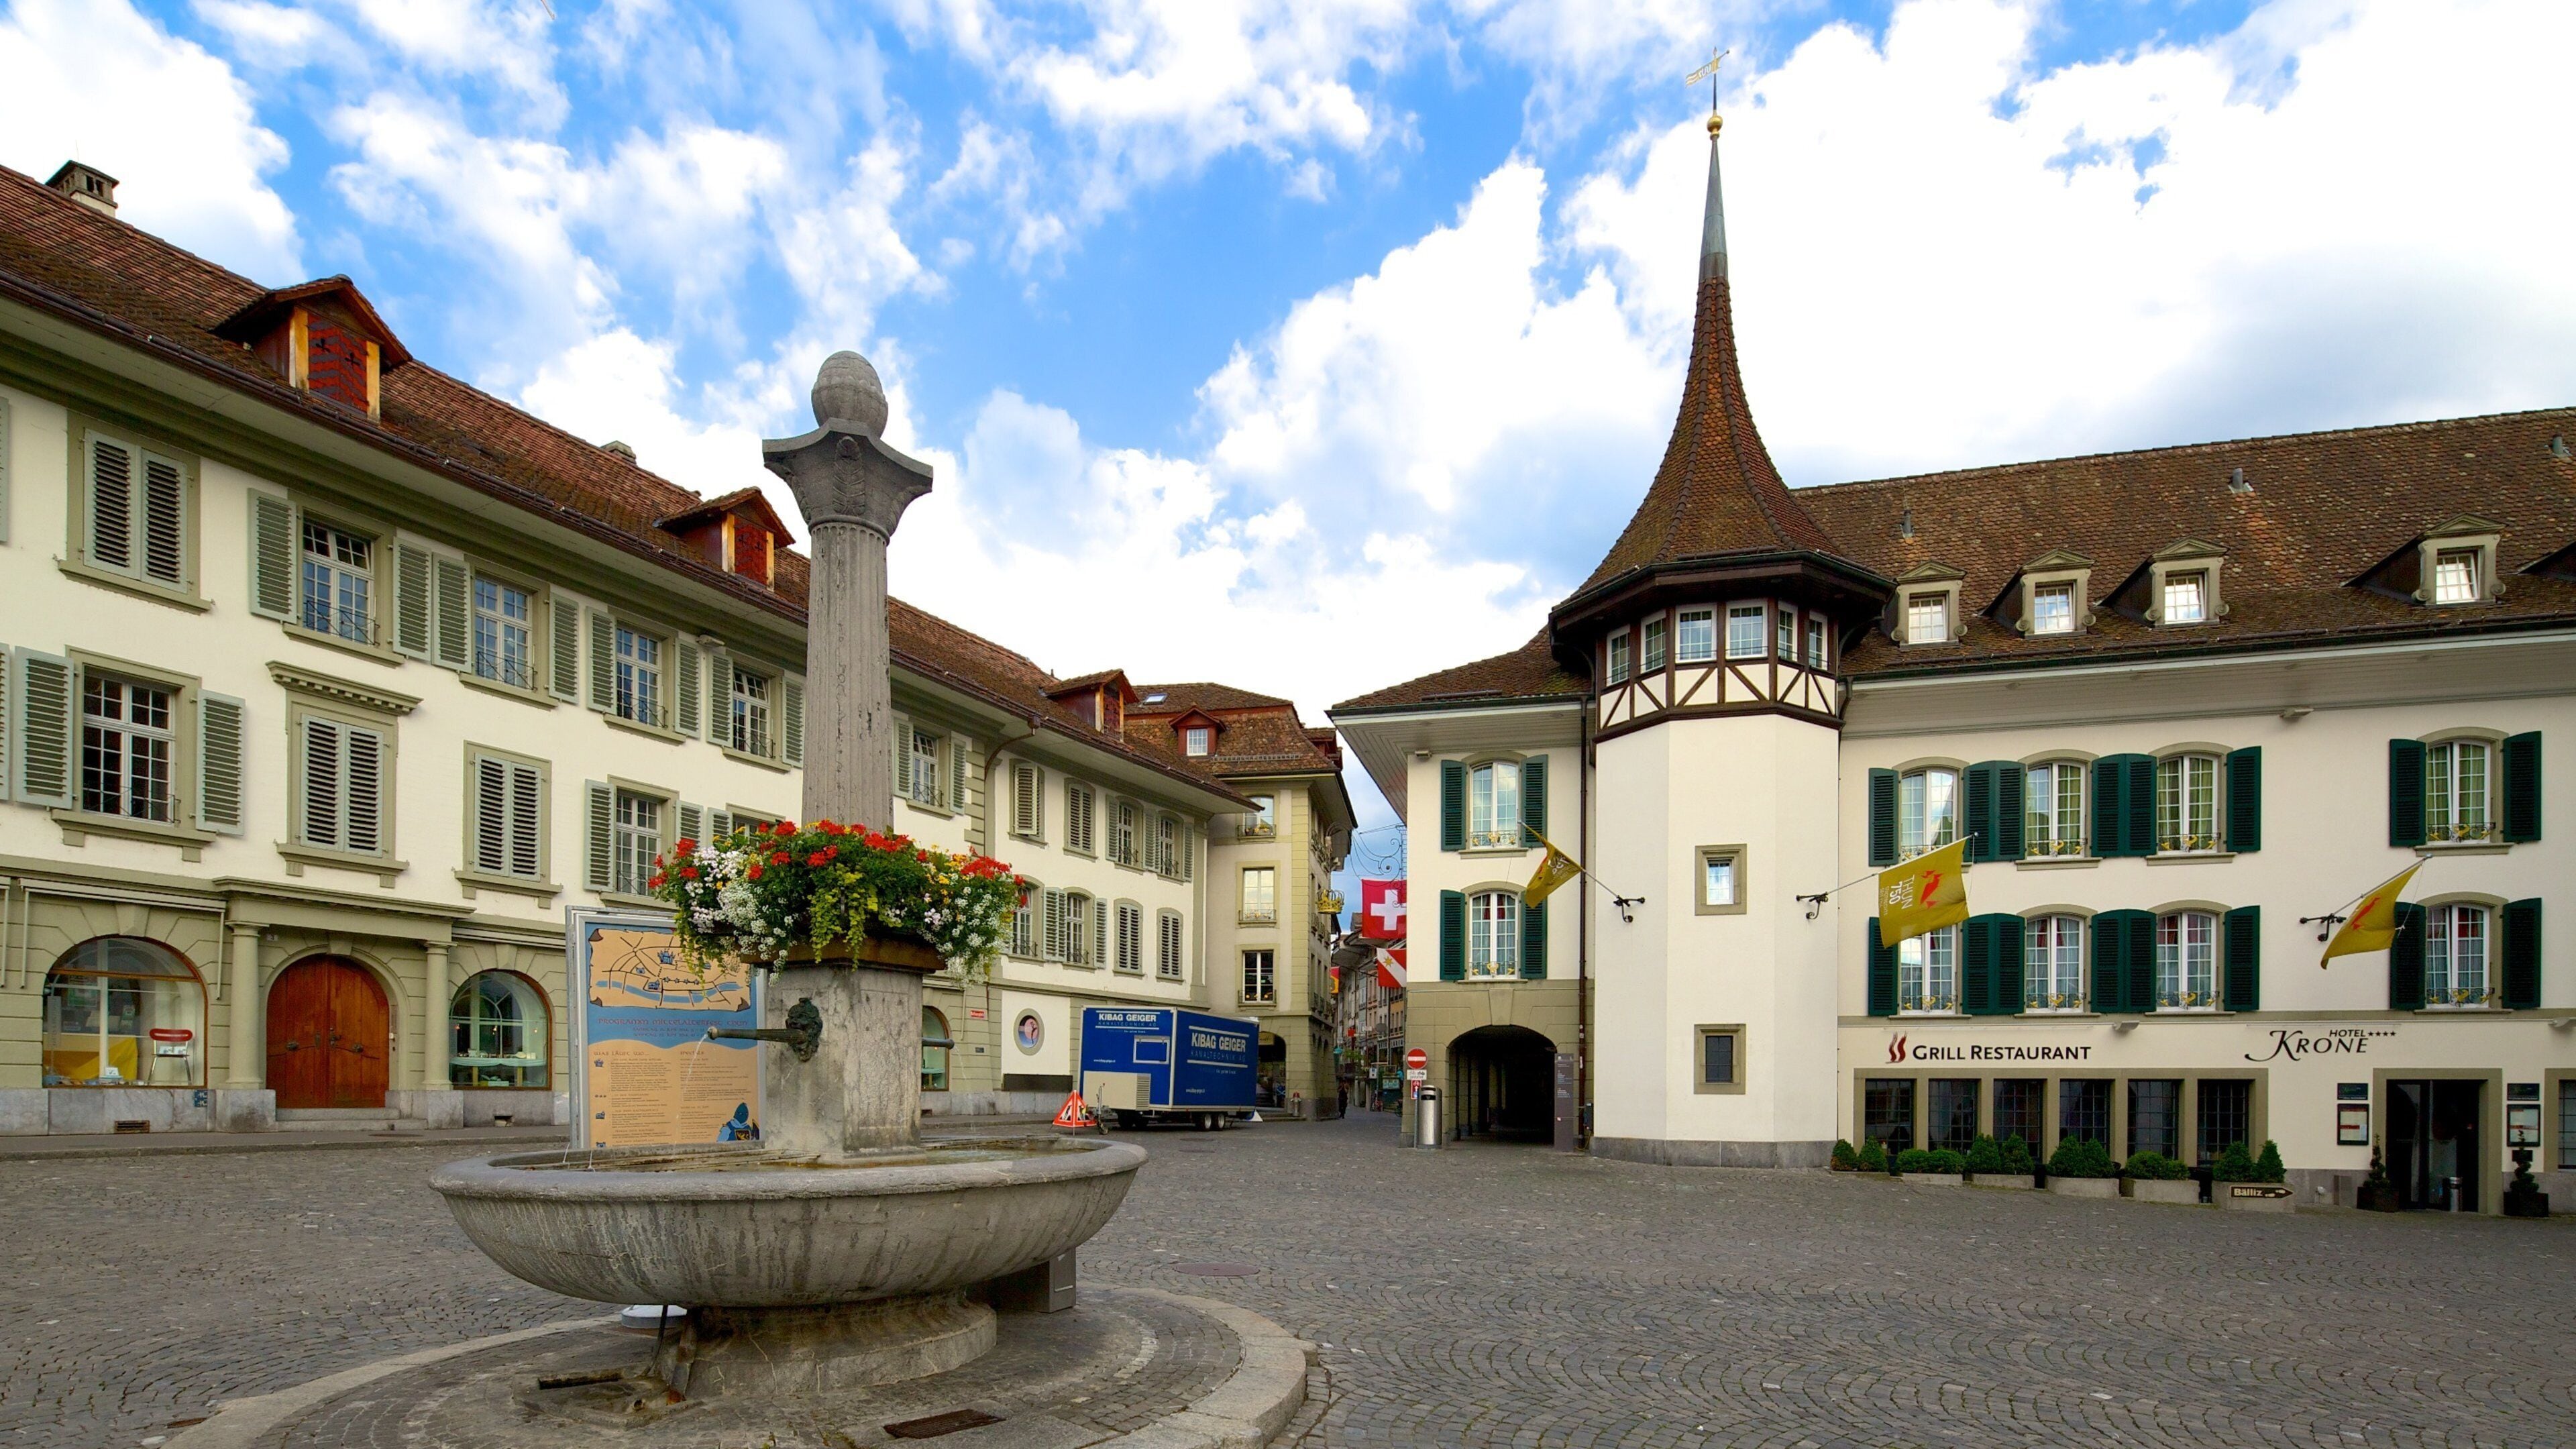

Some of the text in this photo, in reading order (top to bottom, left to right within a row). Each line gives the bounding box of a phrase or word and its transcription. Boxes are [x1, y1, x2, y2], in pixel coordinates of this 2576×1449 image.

[1889, 881, 1902, 904] 750
[1901, 874, 1915, 909] THUN
[1191, 1032, 1216, 1049] KIBAG
[1219, 1036, 1246, 1053] GEIGER
[1913, 1045, 2092, 1060] GRILL RESTAURANT
[2245, 1030, 2369, 1062] KRONE
[2234, 1188, 2263, 1197] Bälliz
